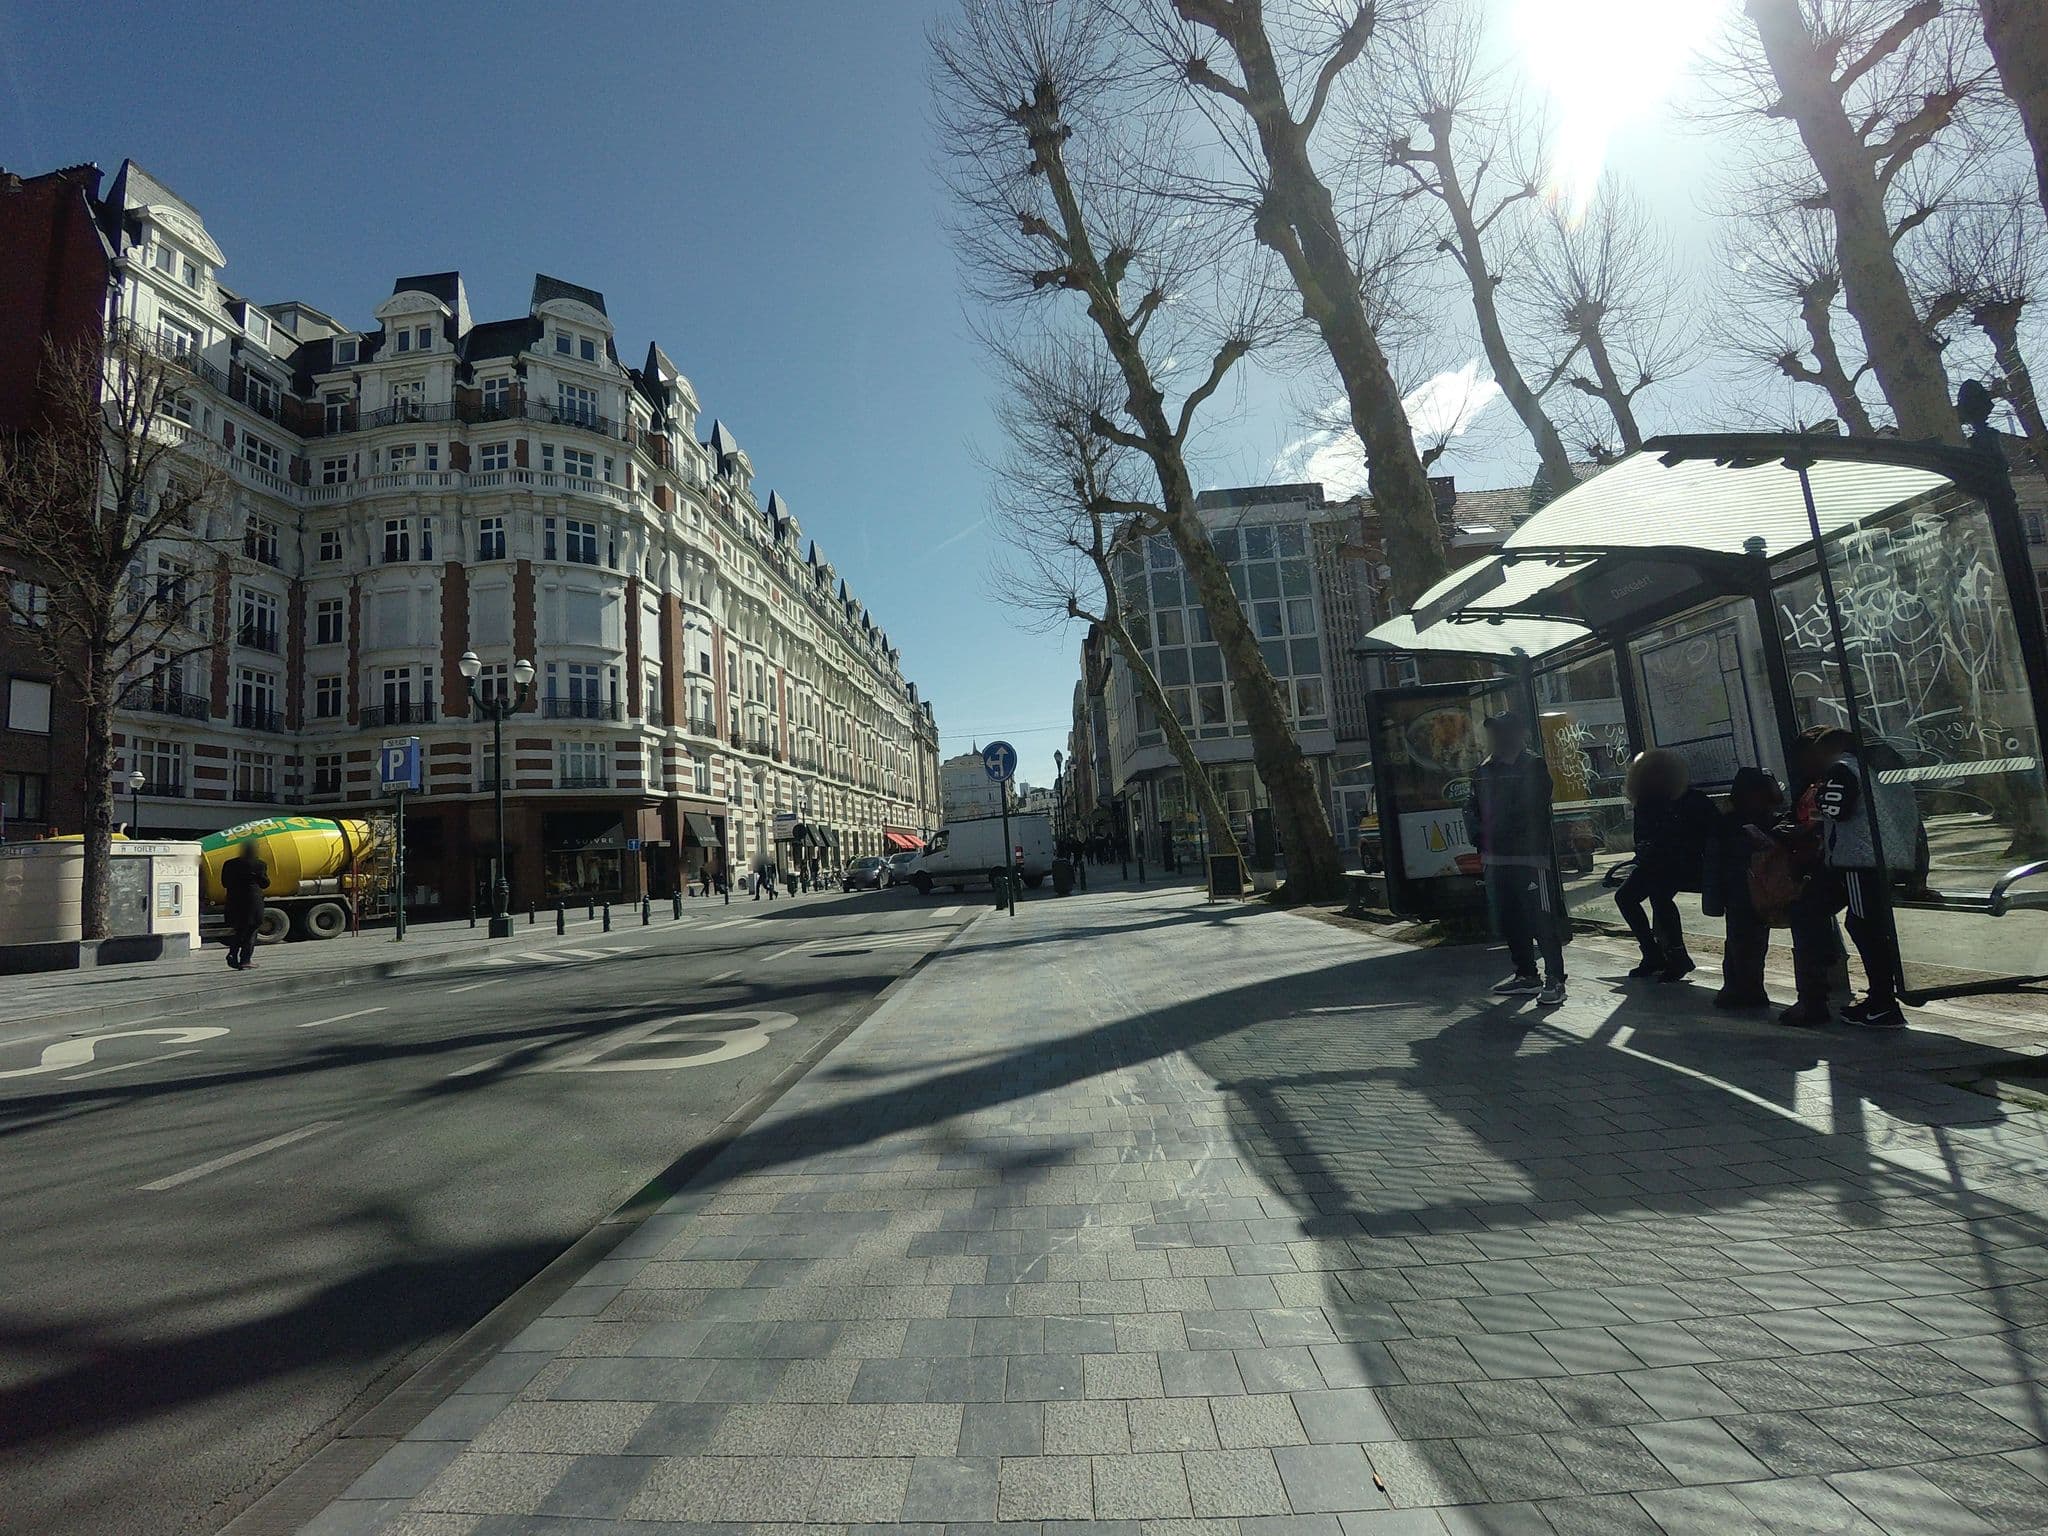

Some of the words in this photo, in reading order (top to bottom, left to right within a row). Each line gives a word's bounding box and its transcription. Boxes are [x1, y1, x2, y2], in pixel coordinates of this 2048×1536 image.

[1610, 574, 1652, 600] Dansaert
[389, 749, 405, 781] P
[134, 845, 157, 853] TOILET
